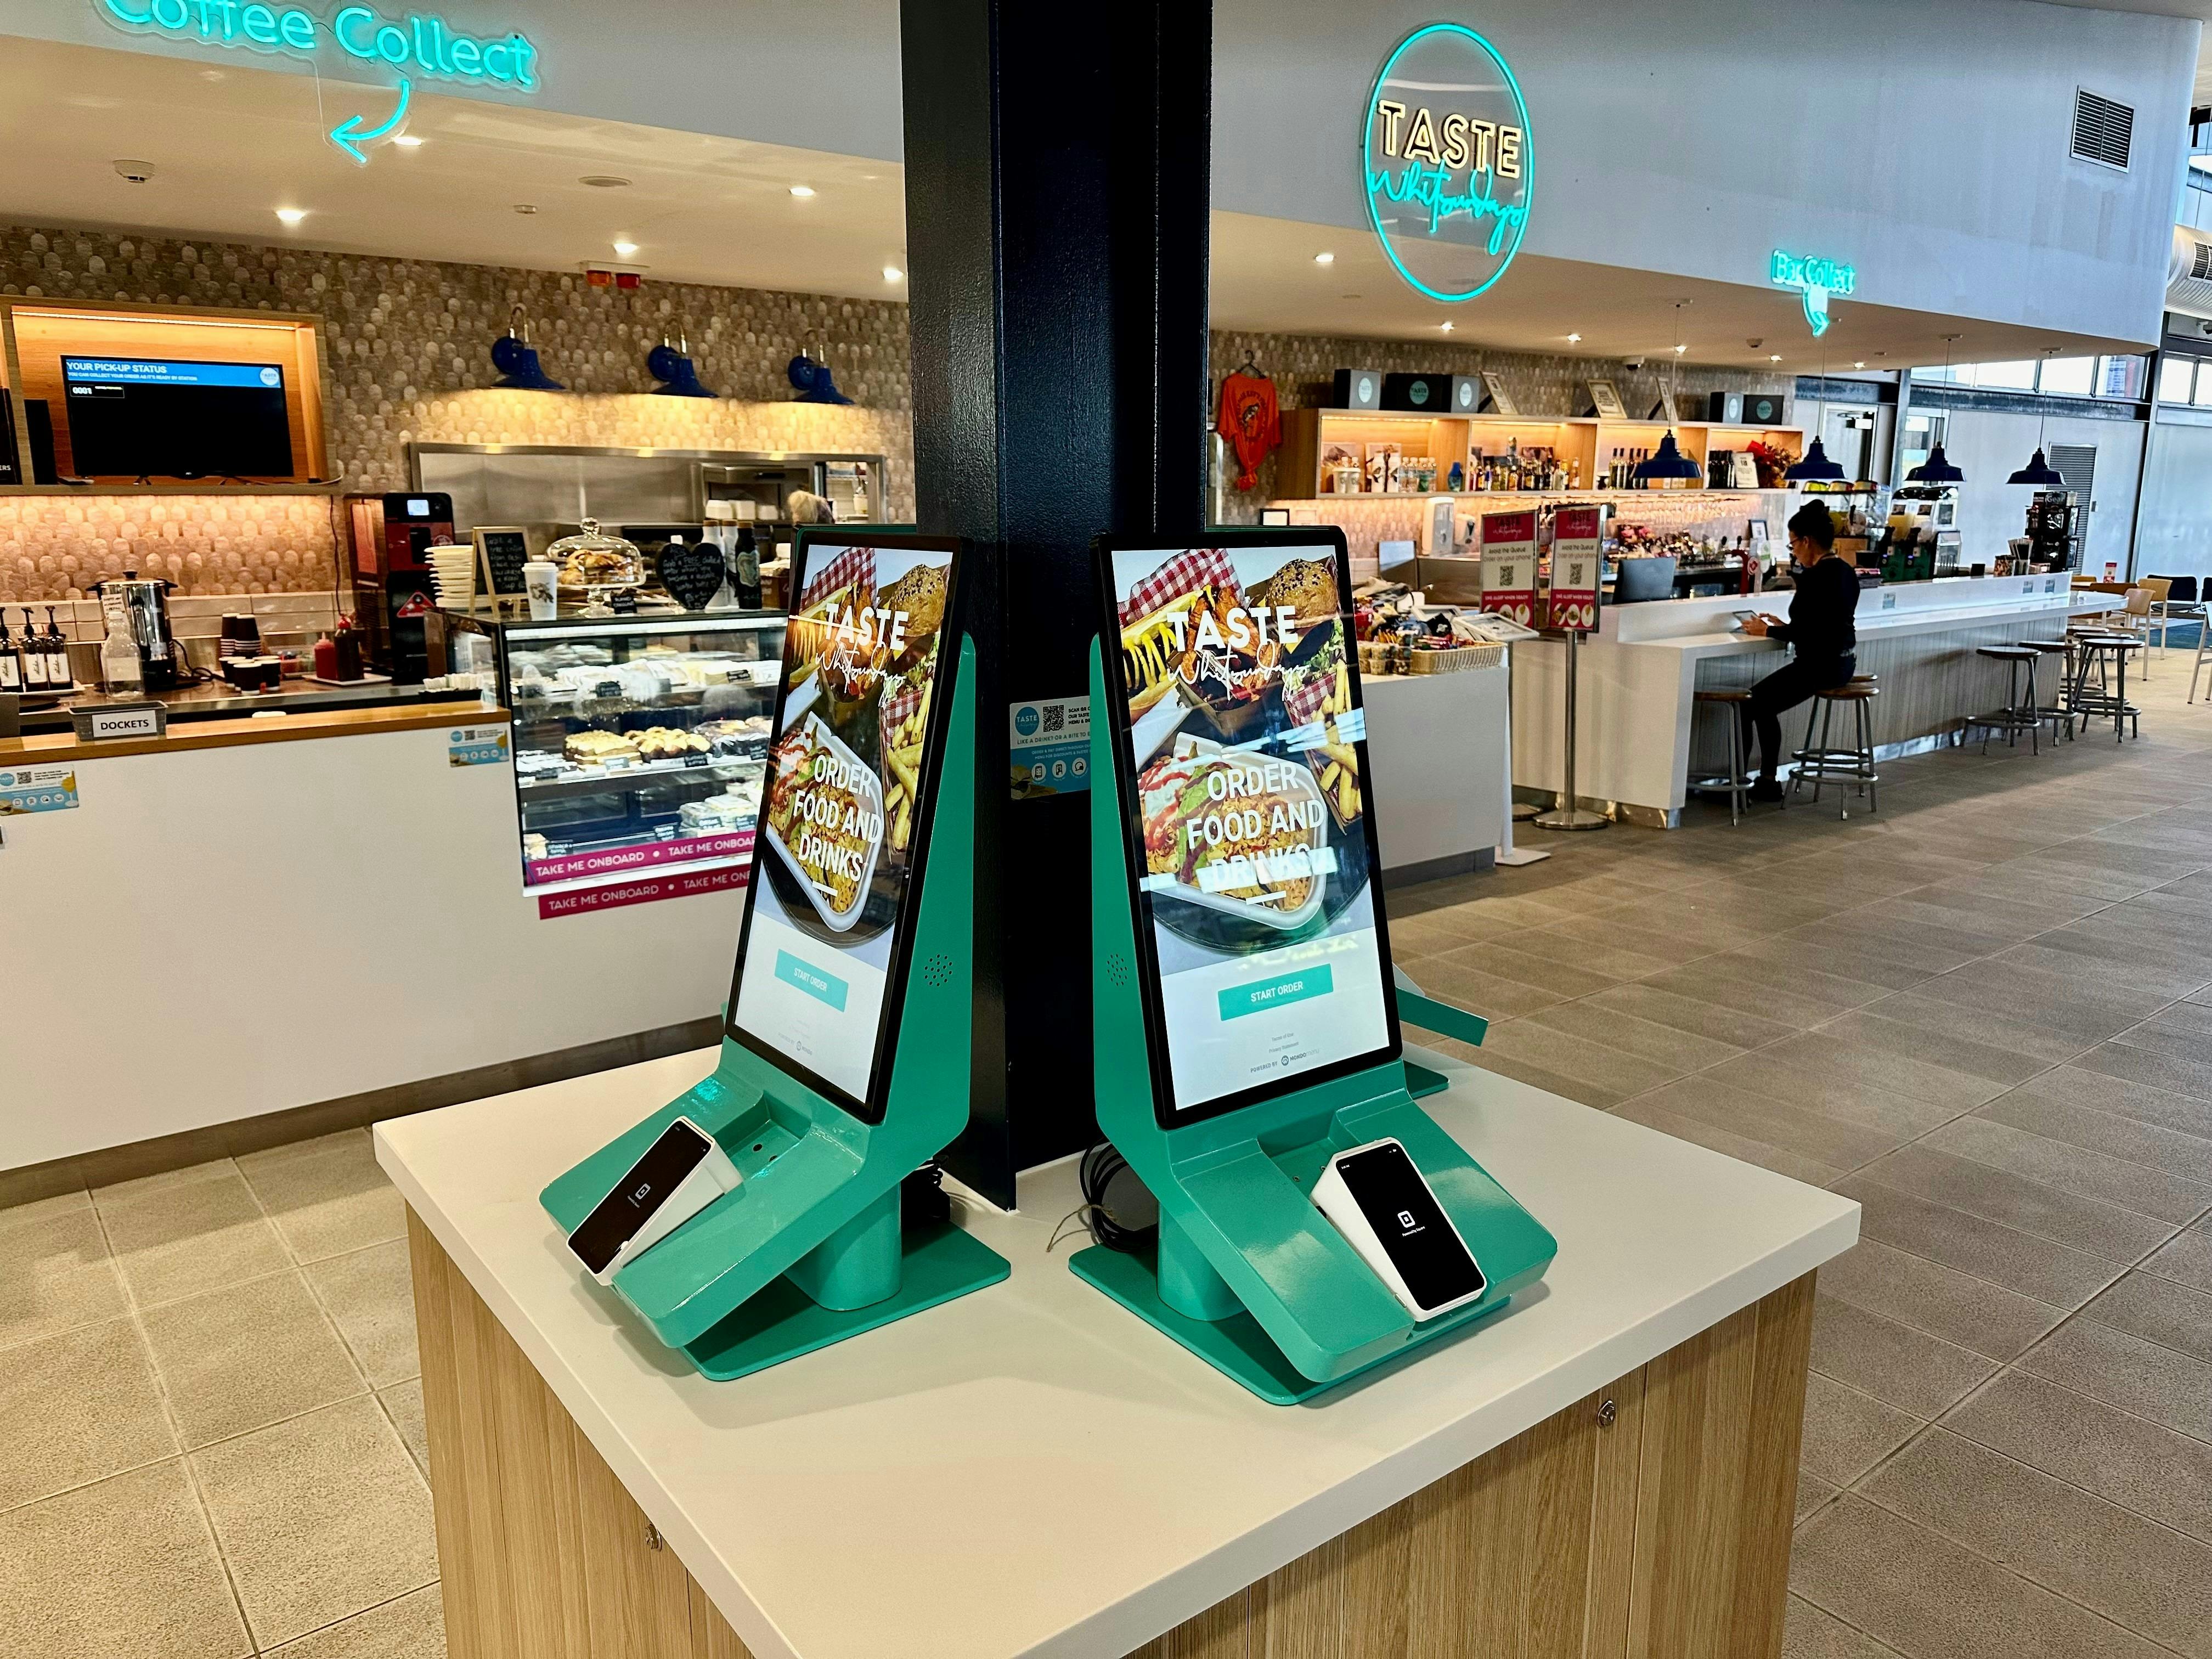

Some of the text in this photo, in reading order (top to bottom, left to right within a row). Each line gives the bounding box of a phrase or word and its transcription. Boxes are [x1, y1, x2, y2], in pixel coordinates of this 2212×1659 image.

[335, 7, 532, 85] Collect
[1379, 99, 1522, 179] TASTE
[1371, 159, 1525, 255] Whitsundays
[1776, 253, 1856, 292] Bar Collect
[66, 362, 167, 373] YOUR PICK-UP STATUS
[826, 603, 910, 651] TASTE
[1167, 605, 1299, 652] TASTE
[815, 639, 907, 710] Whitsundays
[1167, 639, 1311, 702] Whitsundays
[100, 718, 149, 730] DOCKETS
[815, 754, 873, 797] ORDER
[1207, 762, 1299, 801] ORDER
[793, 789, 881, 843] FOOD AND
[1186, 799, 1324, 849] FOOD AND
[536, 864, 565, 877] TAKE
[567, 859, 584, 872] ME
[587, 851, 645, 870] ONBOARD
[668, 844, 693, 857] TAKE
[696, 841, 712, 853] ME
[798, 833, 864, 882] DRINKS
[1211, 843, 1312, 887] DRINKS
[549, 898, 577, 911] TAKE
[580, 894, 597, 906] ME
[601, 885, 659, 902] ONBOARD
[683, 877, 710, 889] TAKE
[713, 873, 728, 885] ME
[794, 967, 827, 992] START ORDER
[1251, 980, 1304, 1002] START ORDER
[1282, 1041, 1299, 1049] Statement
[1250, 1063, 1271, 1073] POWERED
